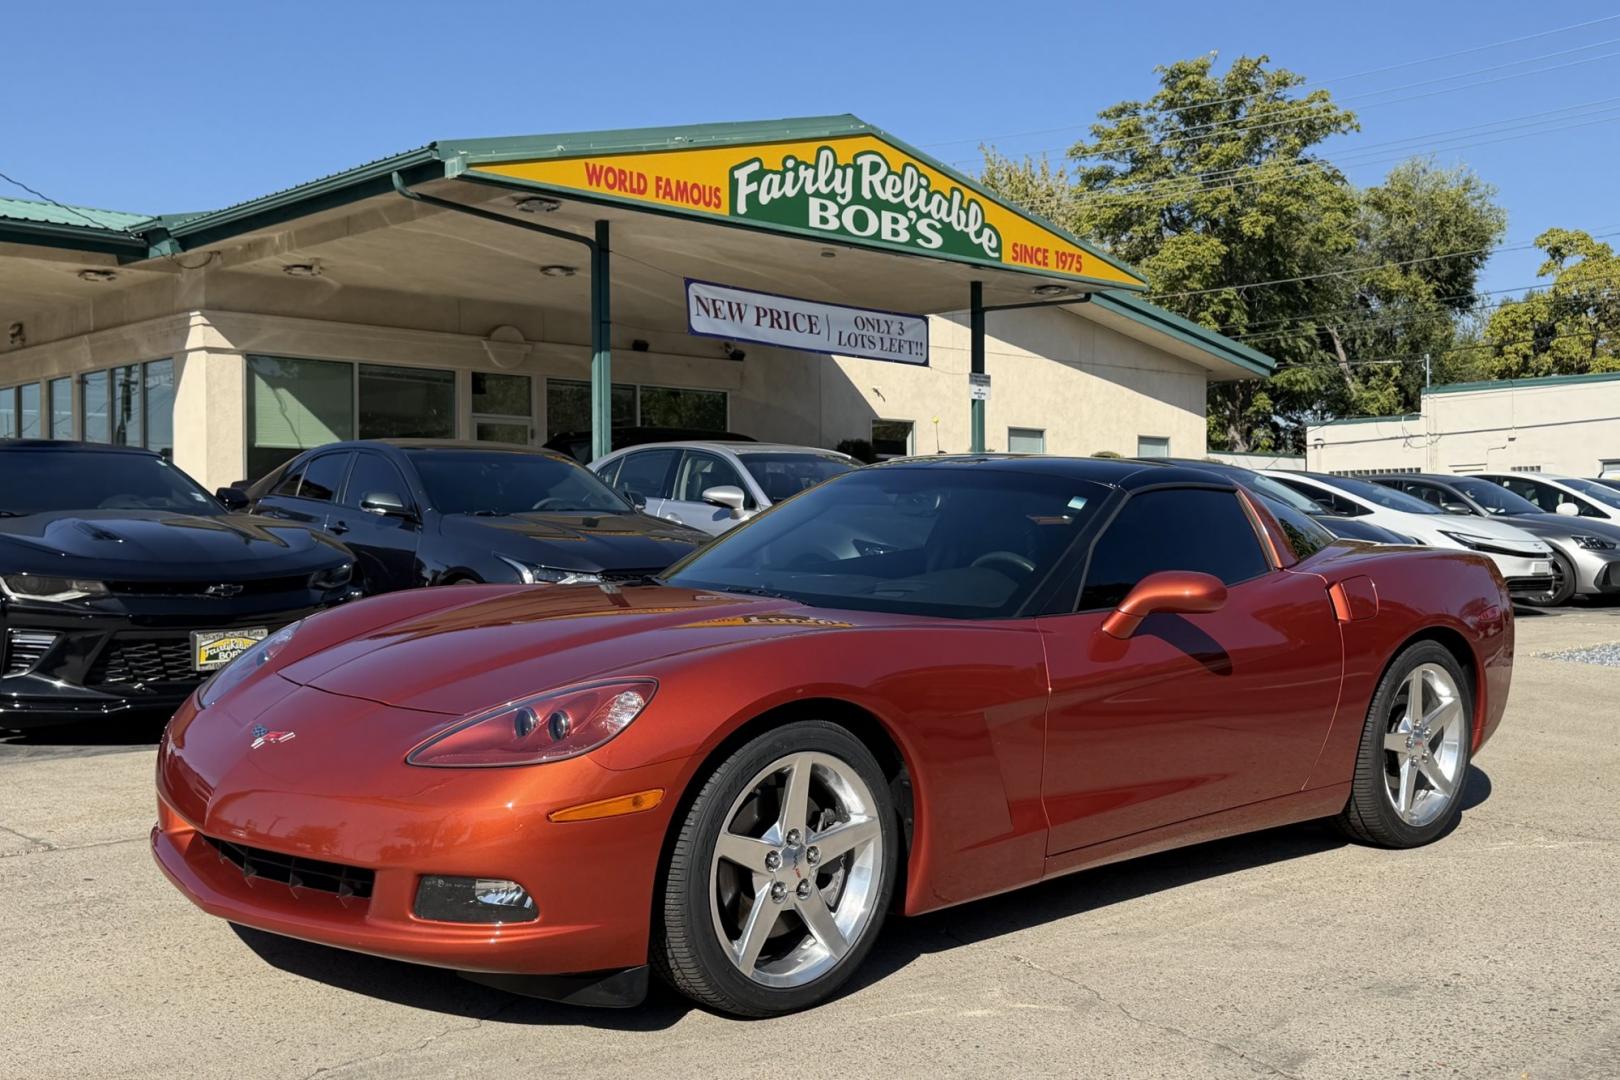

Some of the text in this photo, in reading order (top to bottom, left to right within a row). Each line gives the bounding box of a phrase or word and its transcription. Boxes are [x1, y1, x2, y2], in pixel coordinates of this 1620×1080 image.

[584, 161, 722, 209] WORLD FAMOUS
[734, 149, 999, 257] Fairly Reliable
[808, 196, 944, 249] BOB'S
[1012, 242, 1083, 272] SINCE 1975
[694, 294, 821, 335] NEW PRICE
[854, 315, 905, 336] ONLY 3
[837, 330, 924, 356] LOTS LEFT!!
